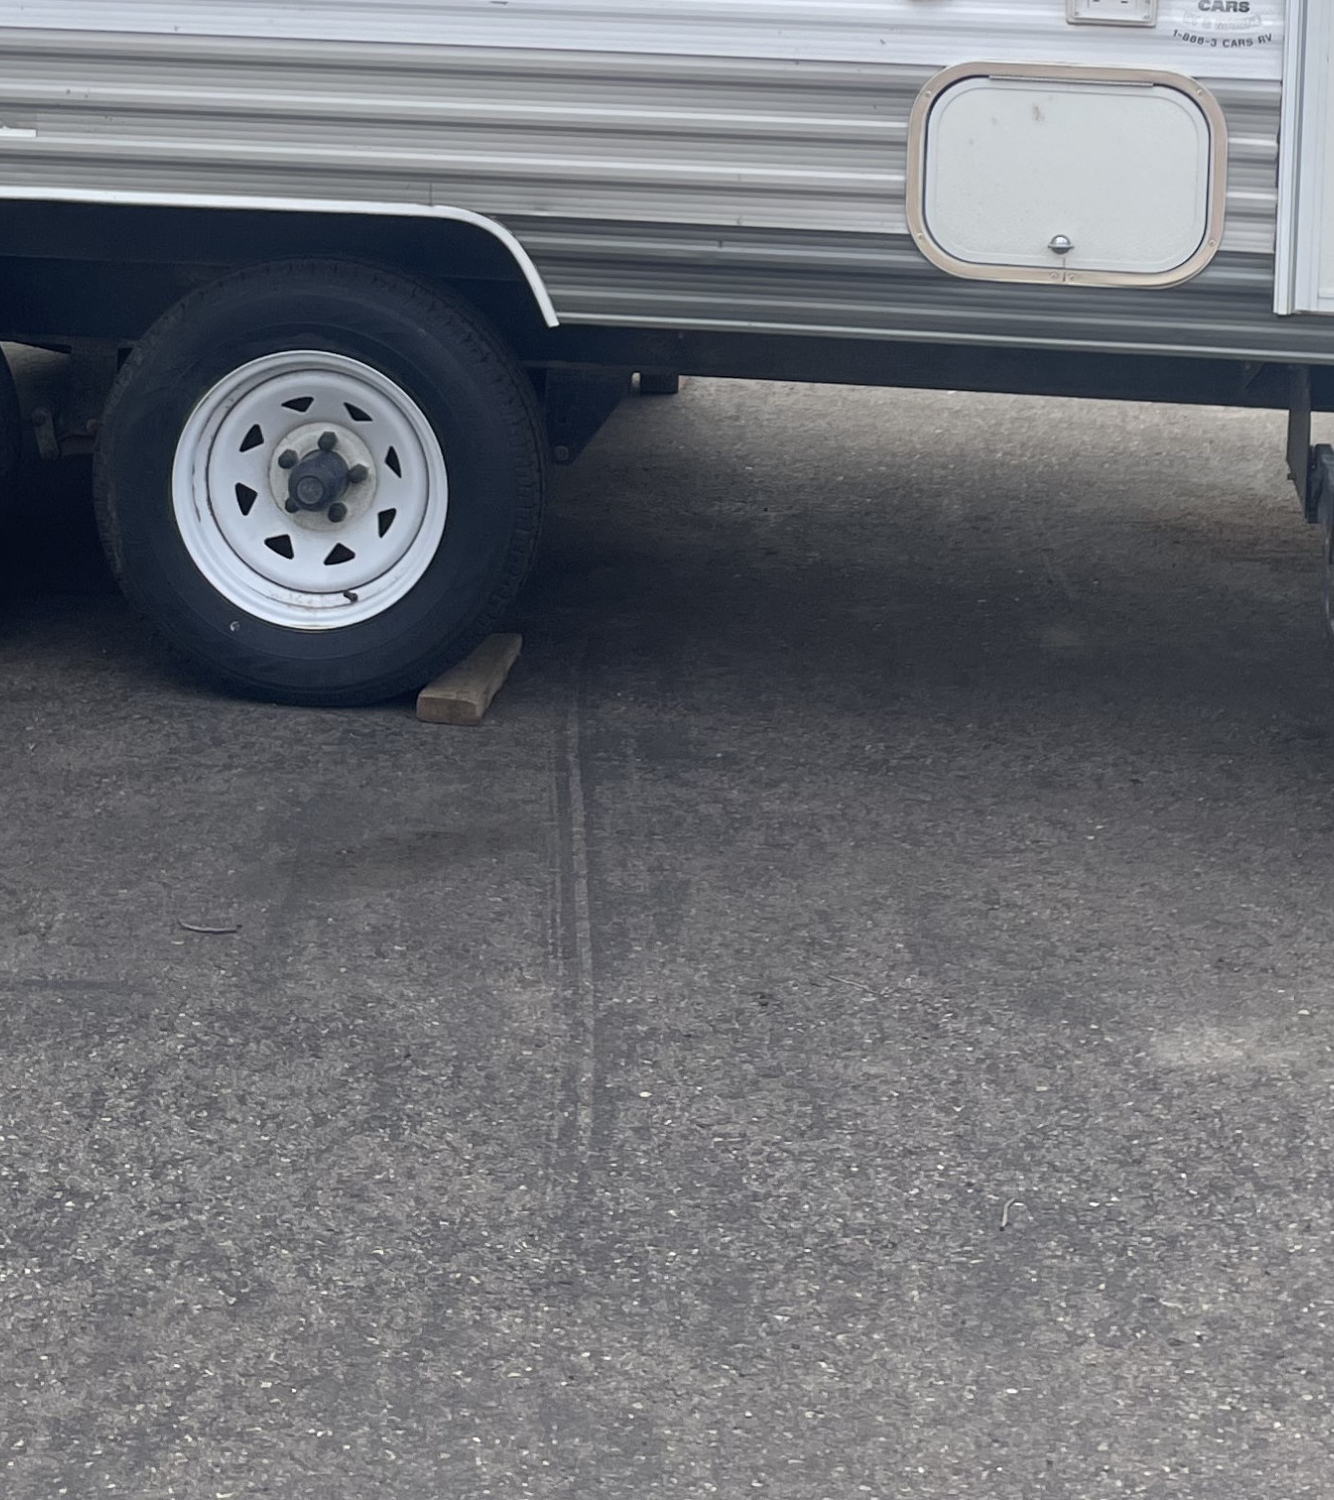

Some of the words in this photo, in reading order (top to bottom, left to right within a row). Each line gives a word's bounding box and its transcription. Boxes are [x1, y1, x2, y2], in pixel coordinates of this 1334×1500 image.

[1197, 0, 1251, 13] CARS
[1222, 38, 1254, 48] CARS
[1258, 33, 1272, 44] RV
